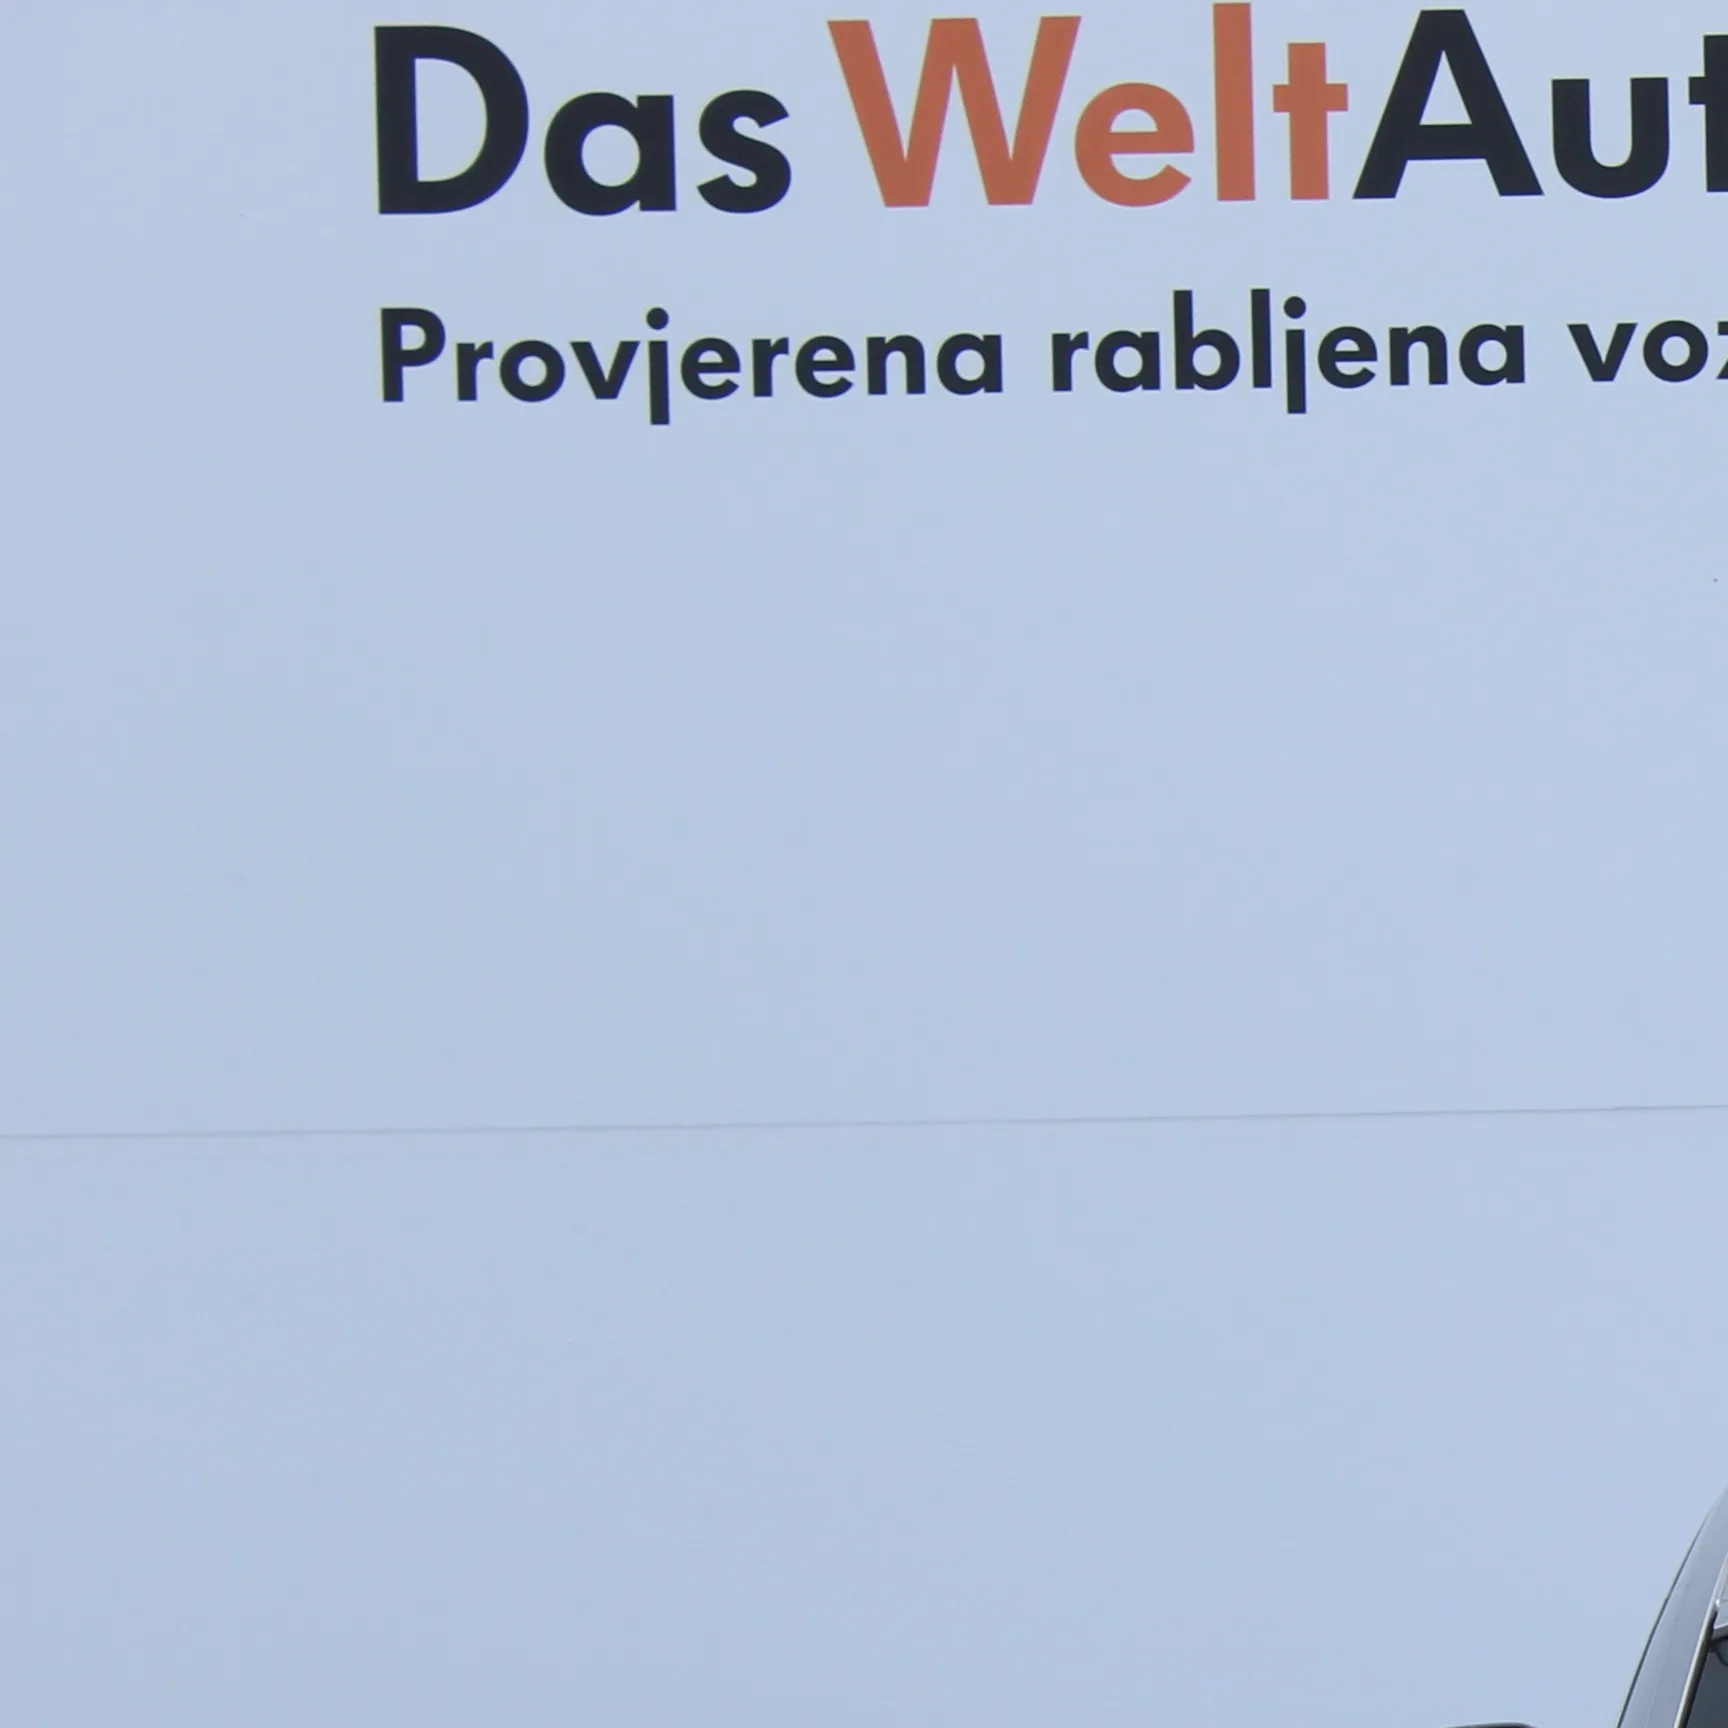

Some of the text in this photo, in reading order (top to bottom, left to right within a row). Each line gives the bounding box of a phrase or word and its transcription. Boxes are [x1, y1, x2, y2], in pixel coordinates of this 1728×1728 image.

[374, 25, 792, 217] Das
[380, 307, 1003, 425] Provjerena
[1051, 288, 1526, 415] rabljena
